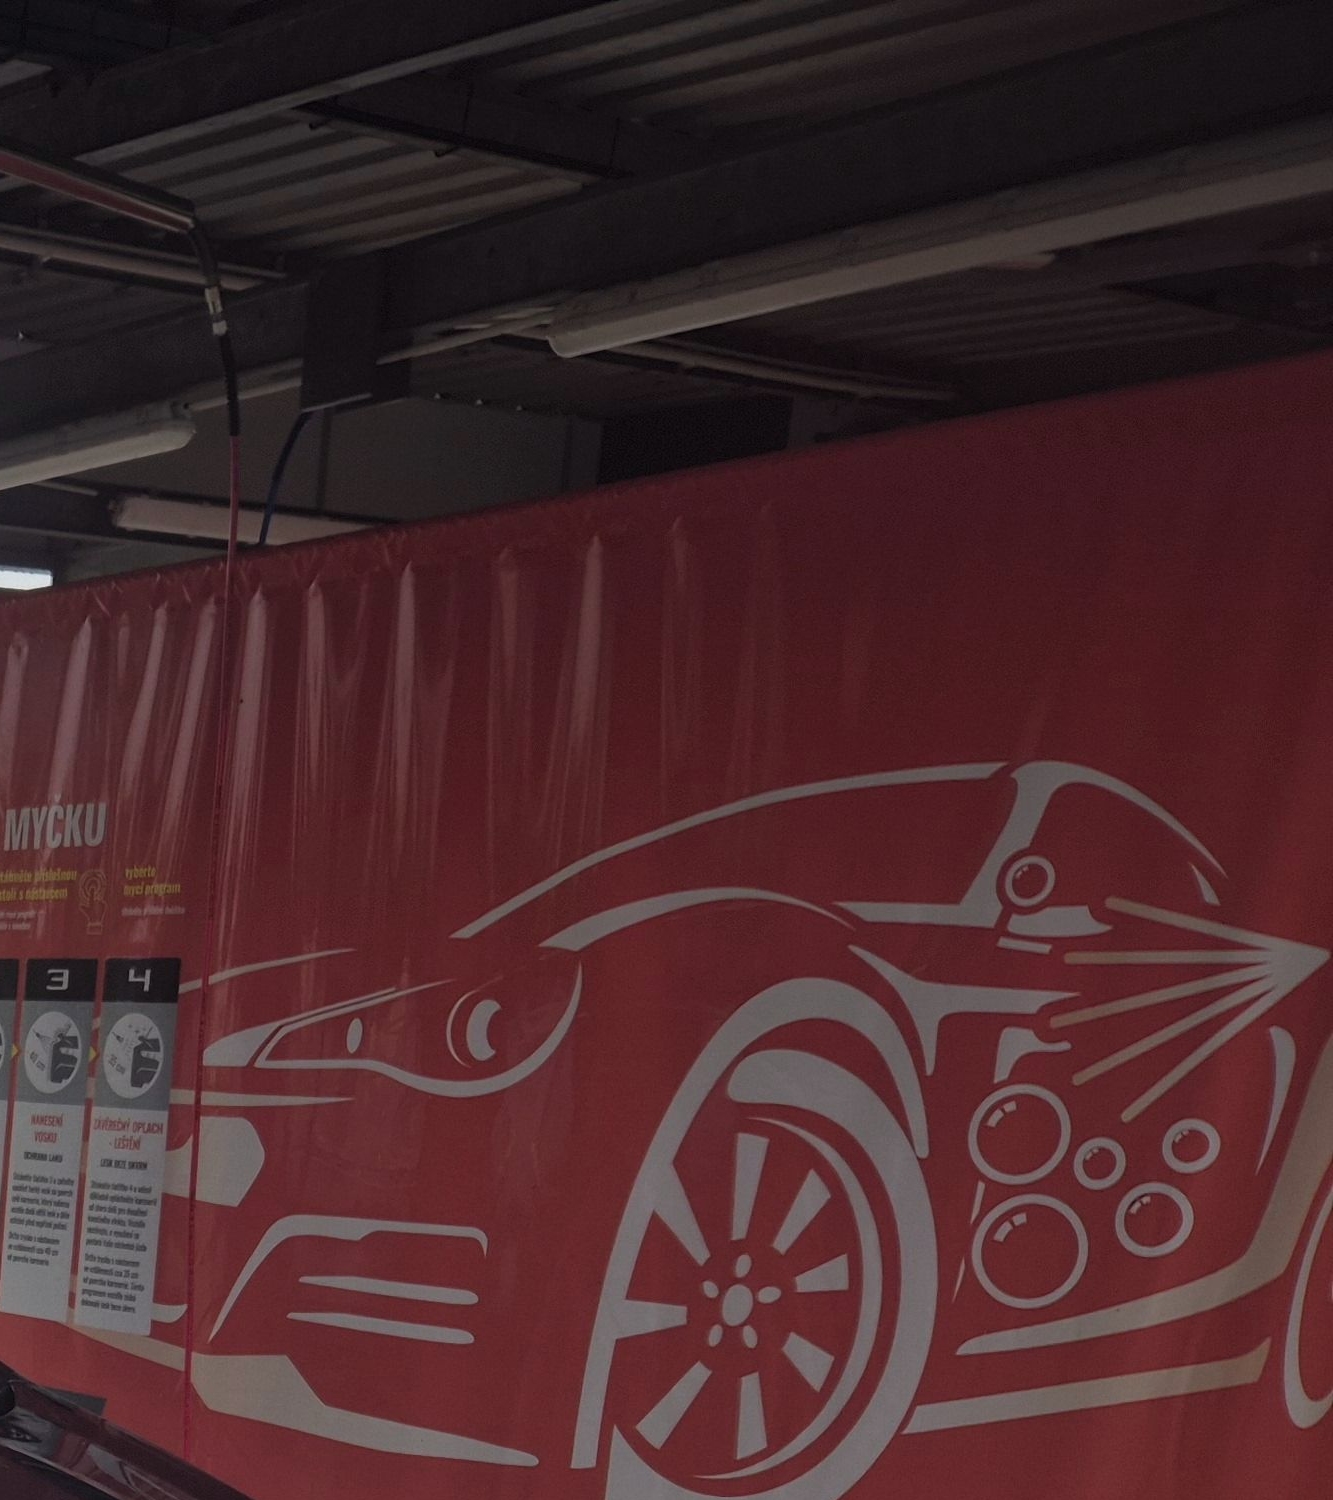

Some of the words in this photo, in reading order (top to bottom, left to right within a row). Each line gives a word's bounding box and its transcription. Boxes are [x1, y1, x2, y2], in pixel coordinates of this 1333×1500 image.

[3, 793, 107, 851] MYČKU
[125, 865, 157, 880] vyberte
[145, 882, 181, 896] program
[46, 969, 70, 991] 3
[128, 969, 151, 992] 4
[132, 1120, 163, 1135] OPLACH
